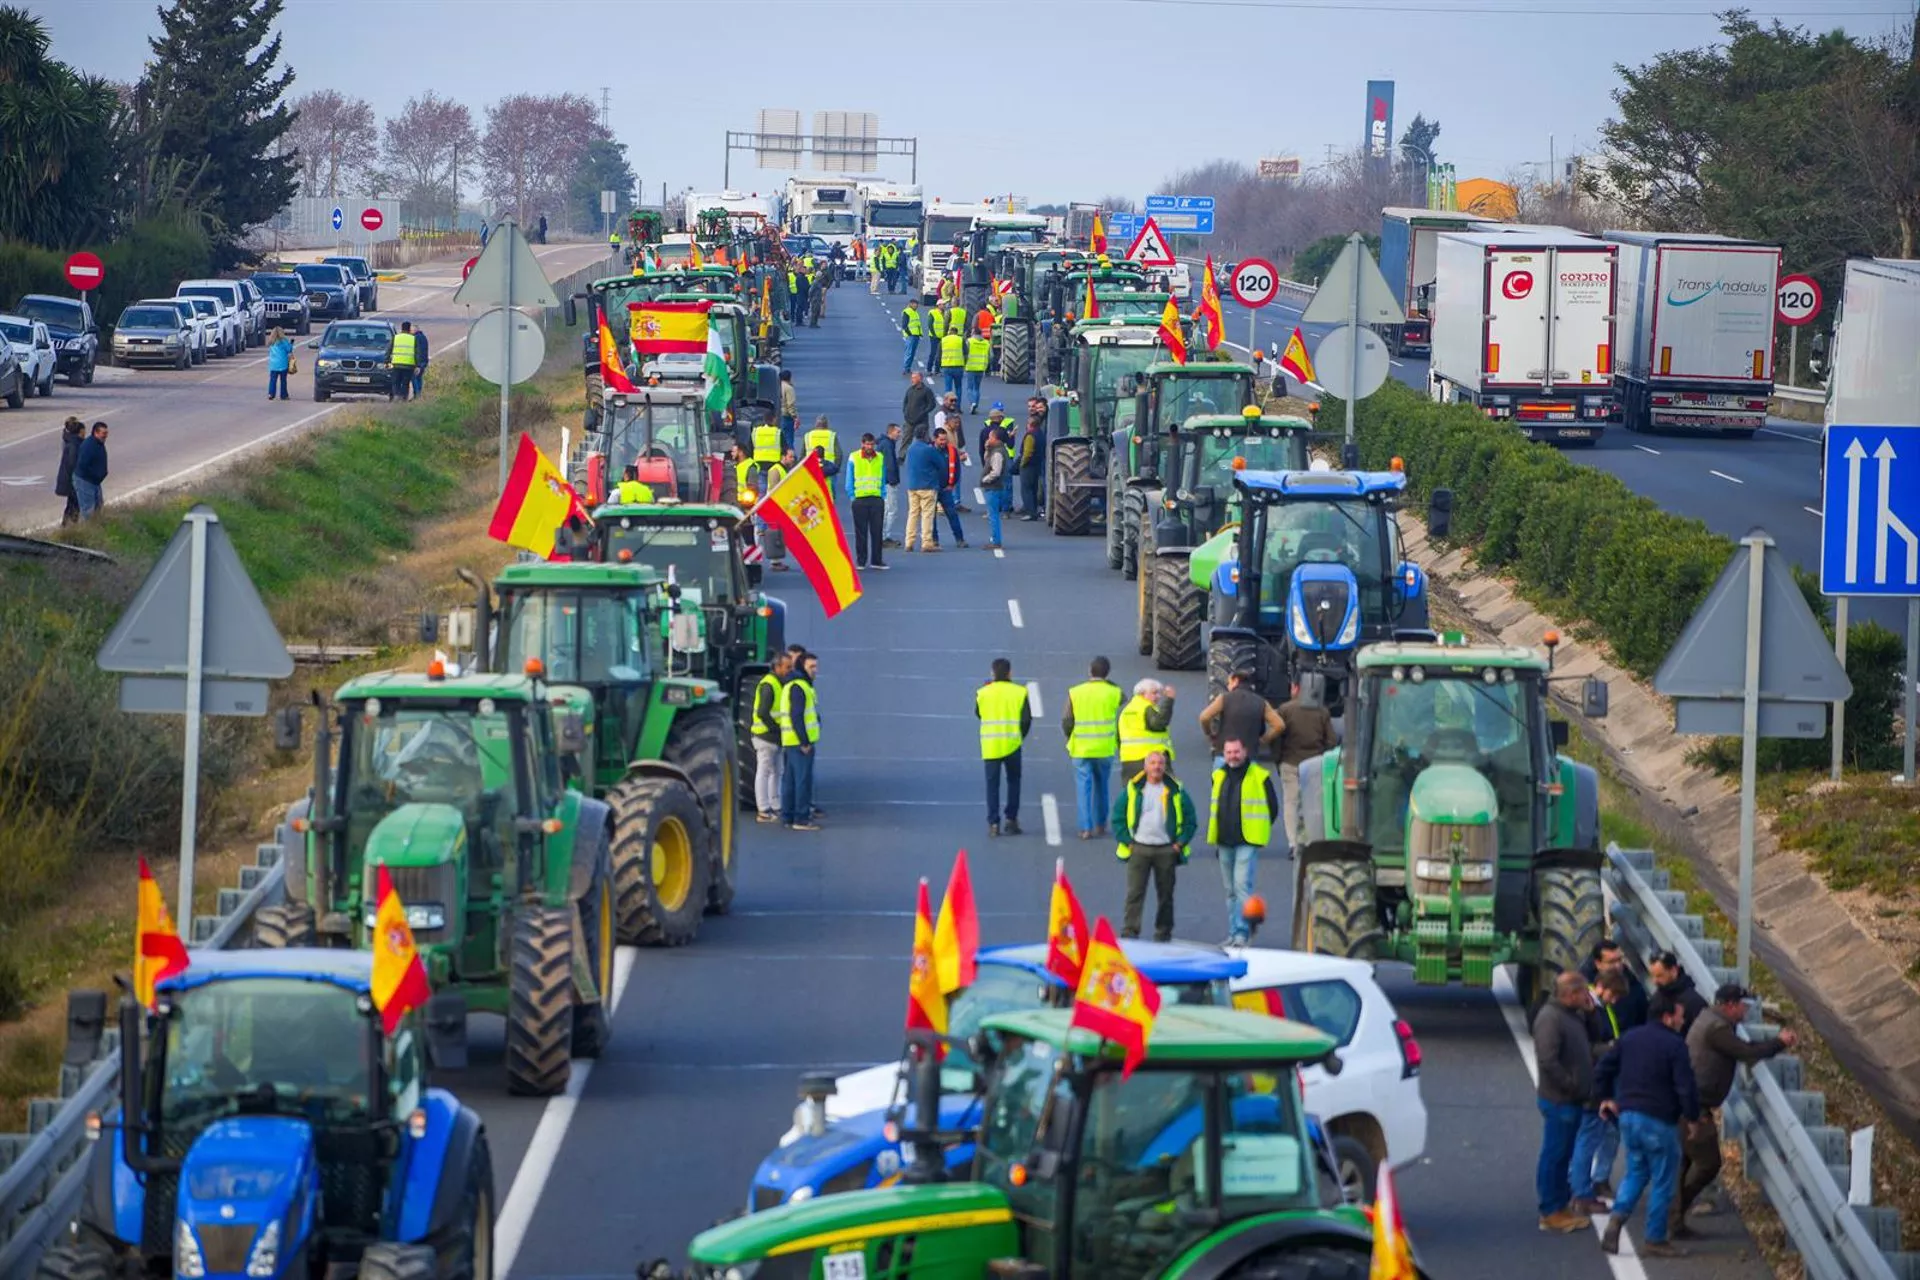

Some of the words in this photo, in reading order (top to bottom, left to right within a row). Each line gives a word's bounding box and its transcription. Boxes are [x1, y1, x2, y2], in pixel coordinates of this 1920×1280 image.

[1238, 275, 1272, 292] 120
[1559, 273, 1608, 281] CORDERO
[1677, 277, 1768, 293] TransAndalus
[1779, 292, 1815, 309] 120
